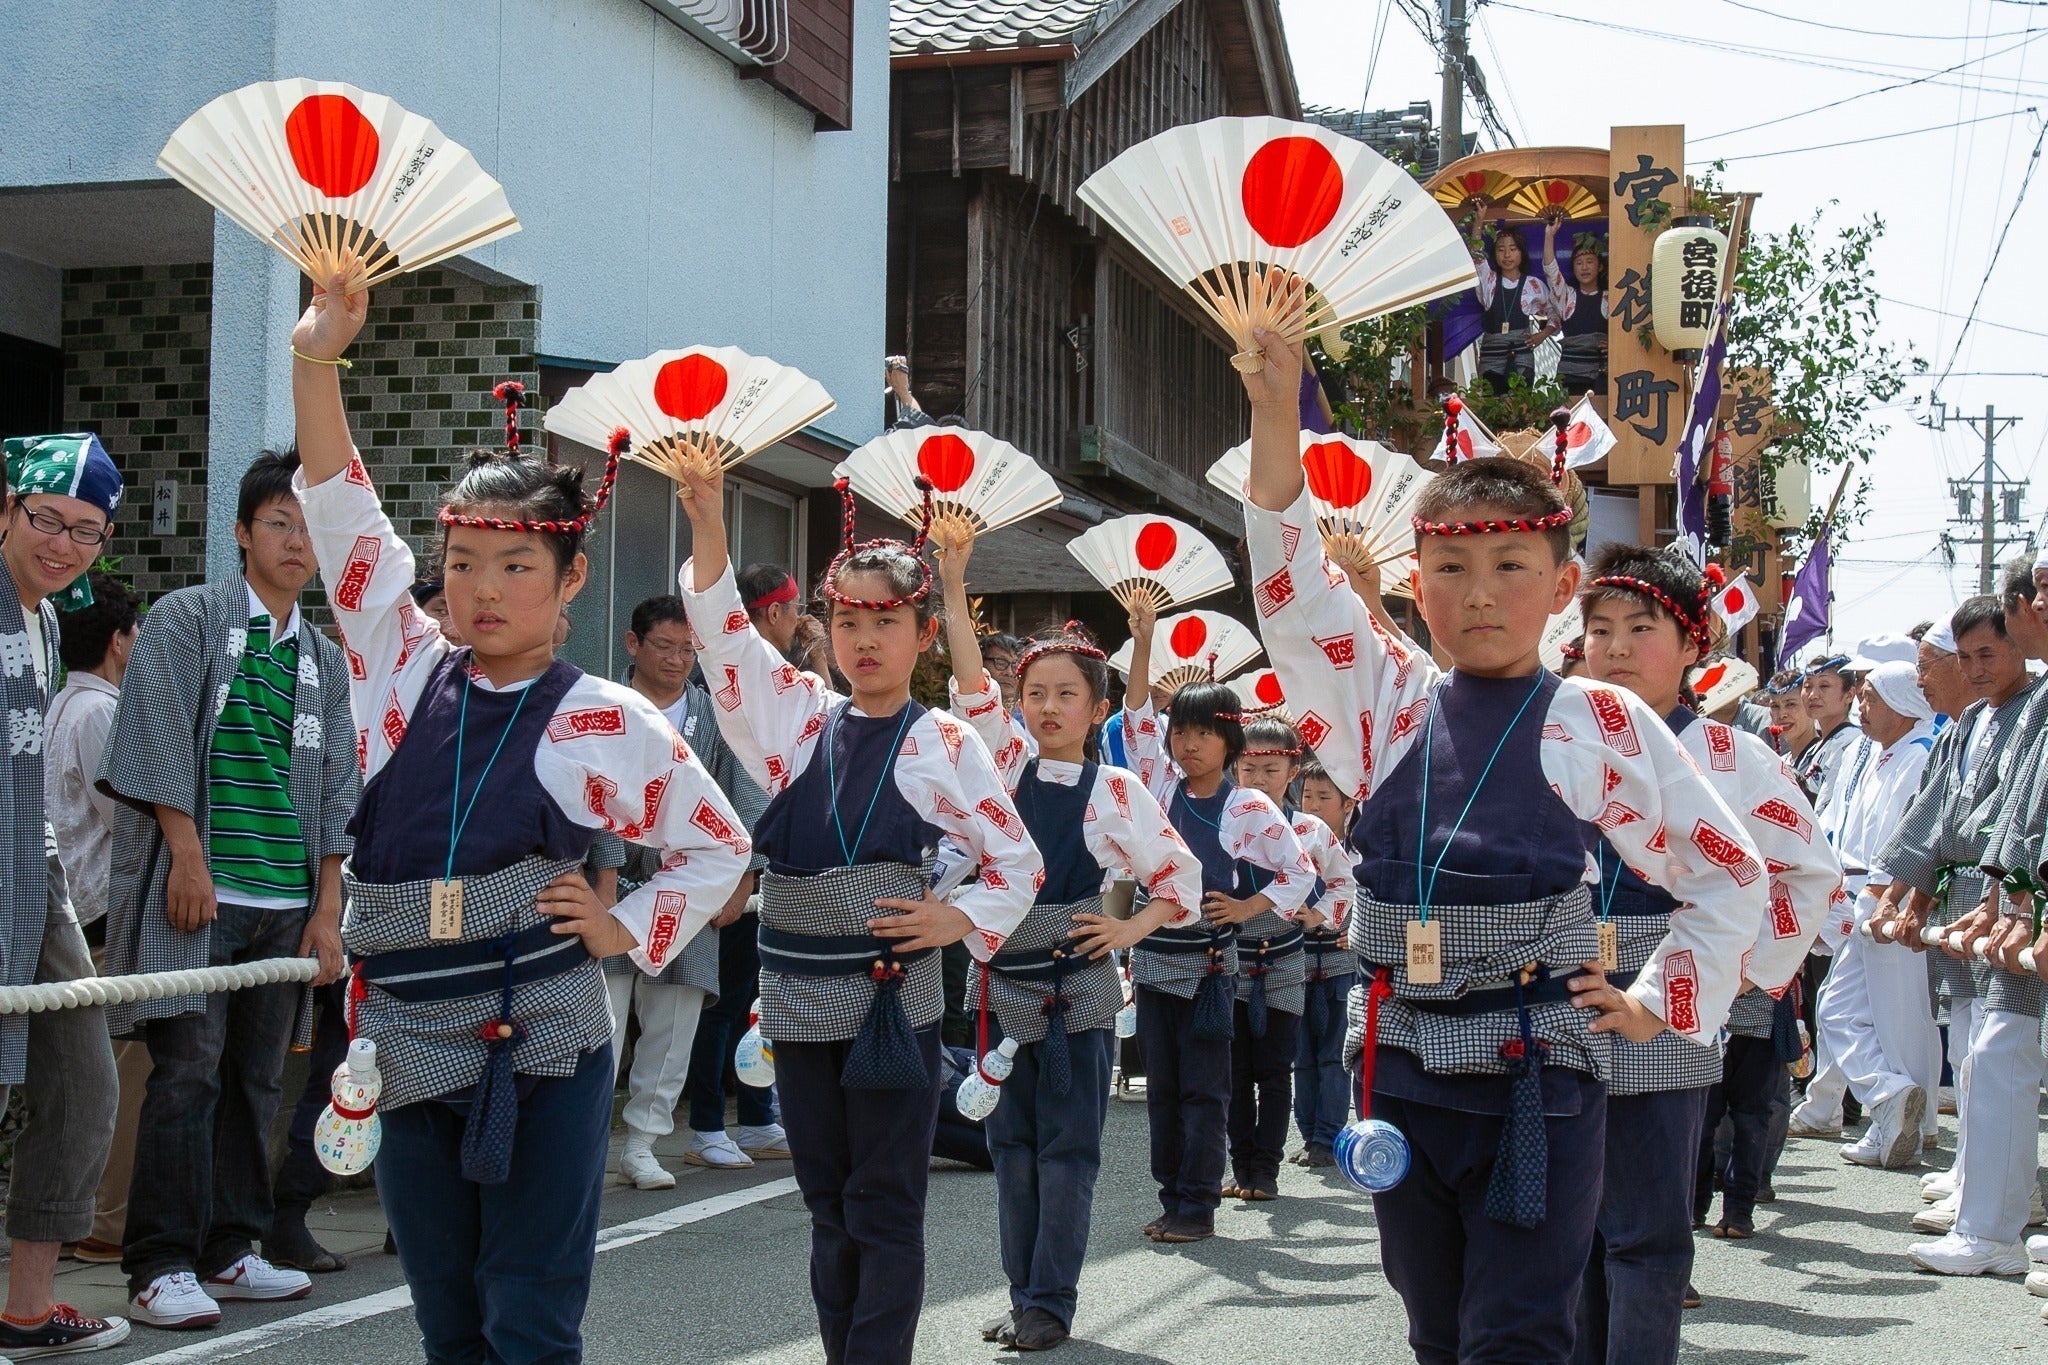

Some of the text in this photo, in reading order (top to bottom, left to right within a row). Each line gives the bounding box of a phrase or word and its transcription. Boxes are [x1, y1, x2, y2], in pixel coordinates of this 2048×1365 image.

[393, 139, 434, 203] 伊勢神宮
[1341, 190, 1401, 256] 伊勢神宮
[1680, 236, 1718, 329] 宮後町
[732, 375, 769, 419] 伊勢神宮
[980, 458, 1008, 497] 伊勢神宮
[1385, 471, 1413, 514] 伊勢神宮
[1760, 468, 1777, 517] 後町
[156, 486, 171, 528] 松井
[294, 656, 322, 750] 宮後
[440, 892, 448, 935] 浜参宮之証
[1668, 976, 1694, 1033] 宮後
